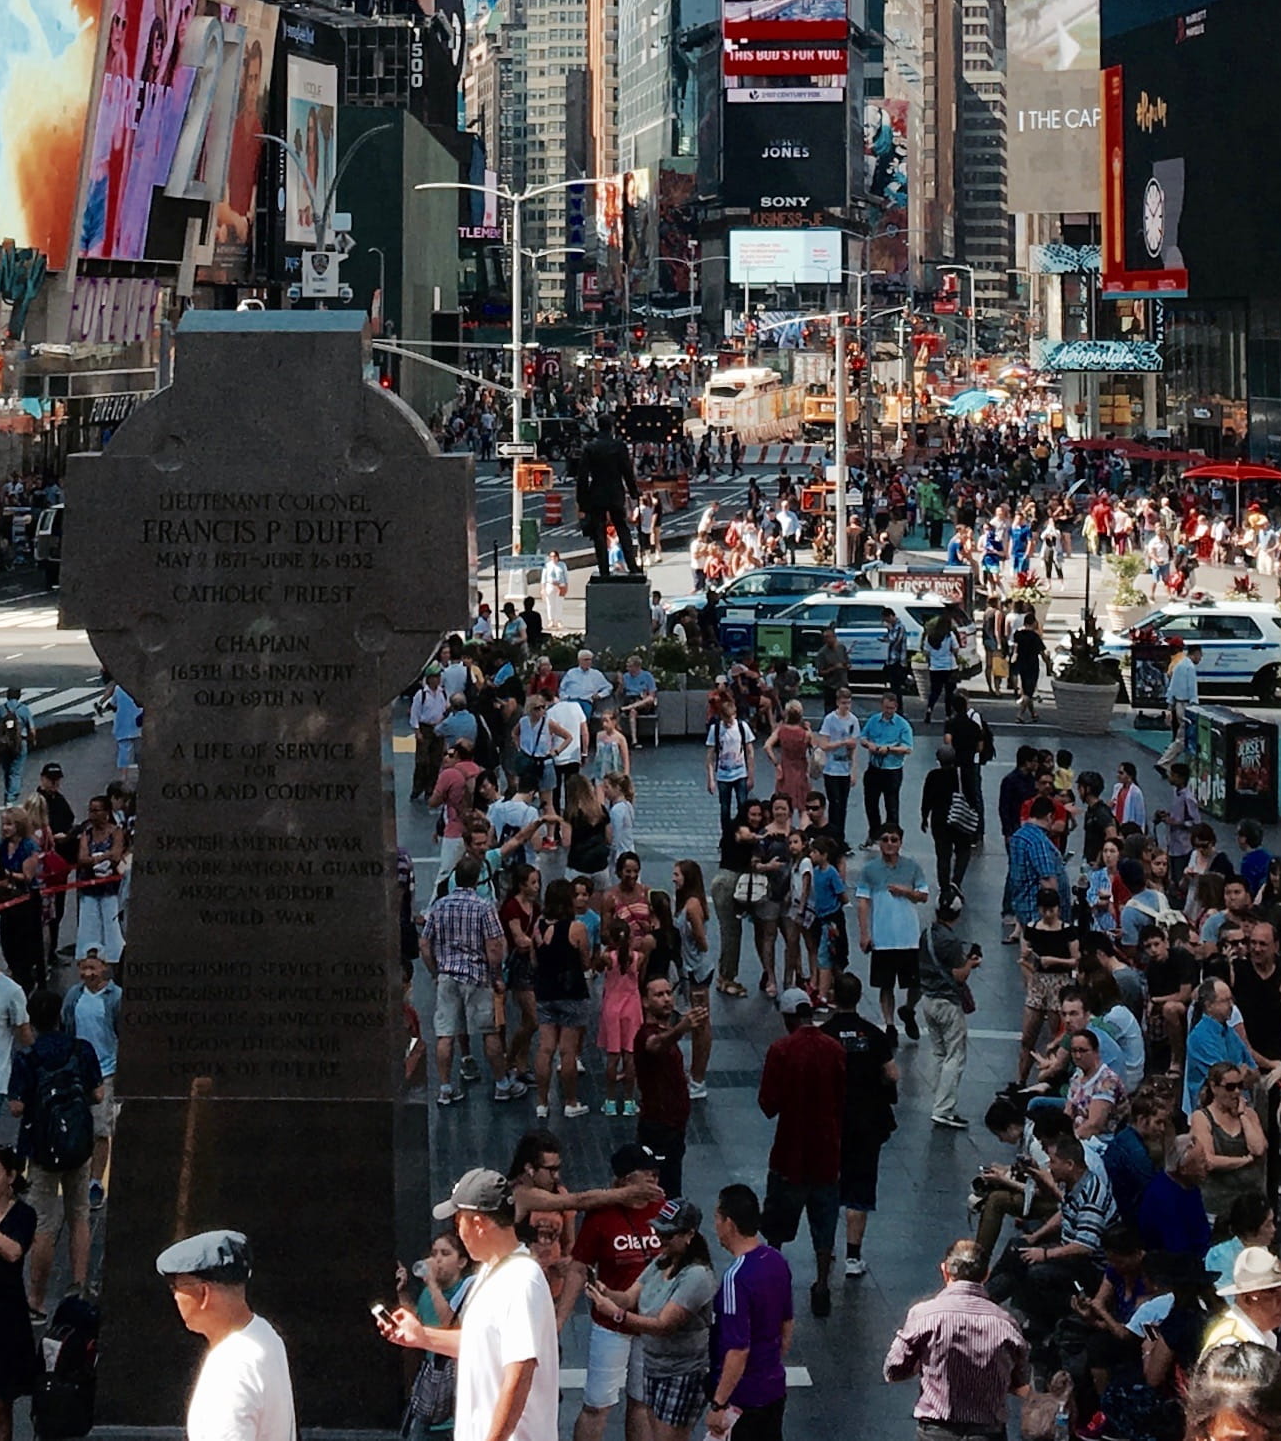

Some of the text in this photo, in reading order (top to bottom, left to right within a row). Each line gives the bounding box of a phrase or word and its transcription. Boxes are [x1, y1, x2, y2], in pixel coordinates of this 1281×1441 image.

[1029, 111, 1062, 129] THE
[762, 146, 810, 159] JONES
[760, 196, 811, 207] SONY
[159, 493, 372, 512] LIEUTENANT COLONEL
[141, 520, 391, 544] FRANCIS P DUFFY
[156, 552, 374, 569] MAY 1932
[173, 585, 356, 603] CATHOLIC PRIEST
[194, 690, 234, 706] OLD
[194, 744, 232, 760] LIFE
[275, 744, 355, 760] SERVICE
[161, 783, 360, 800] GOD AND COUNTRY
